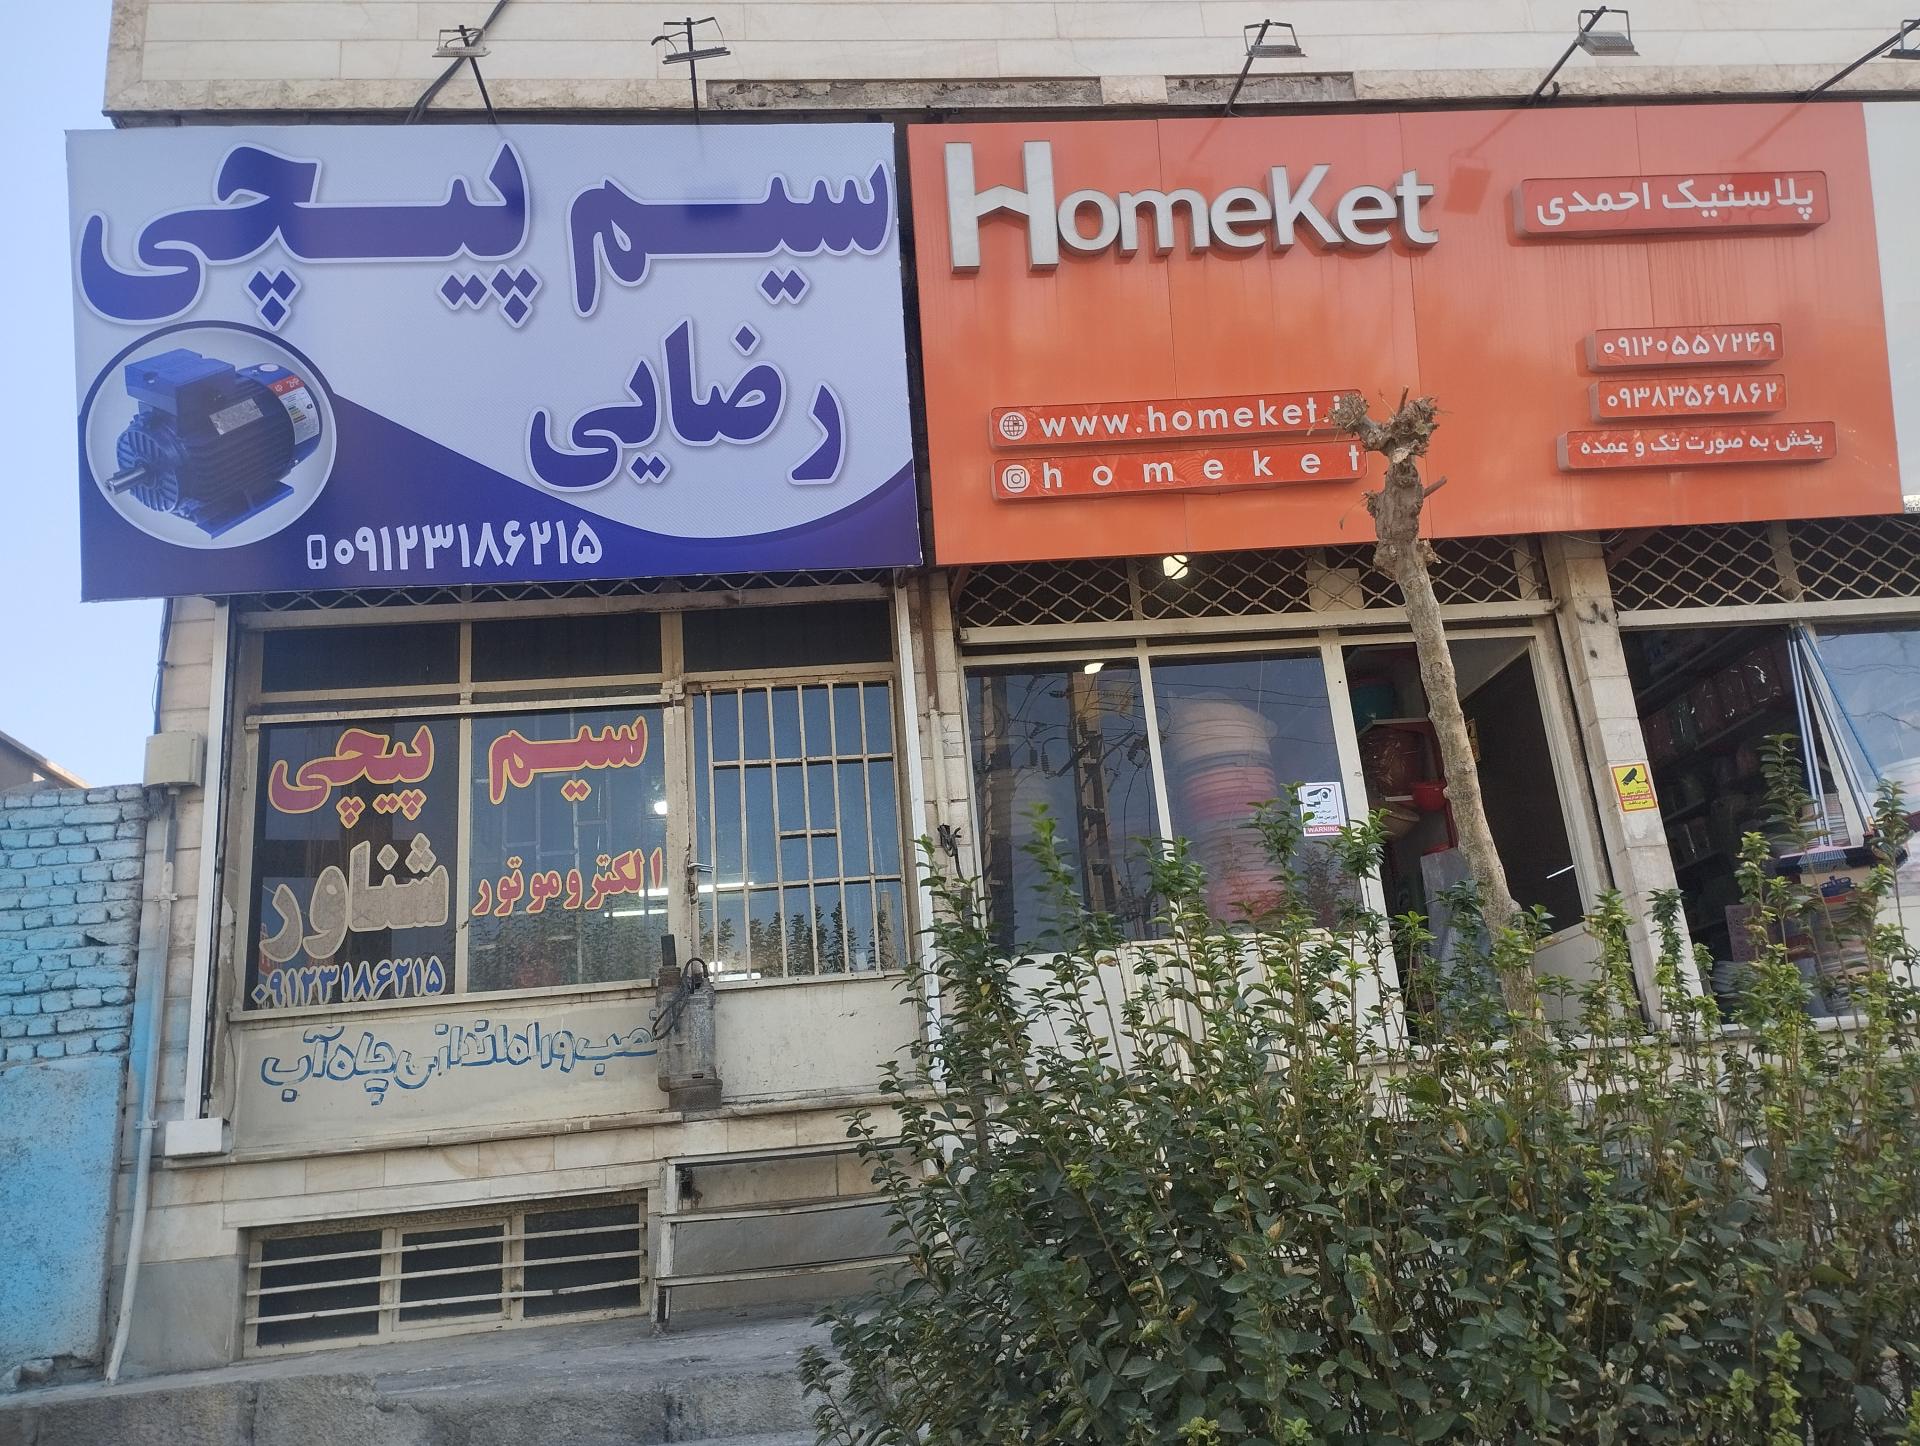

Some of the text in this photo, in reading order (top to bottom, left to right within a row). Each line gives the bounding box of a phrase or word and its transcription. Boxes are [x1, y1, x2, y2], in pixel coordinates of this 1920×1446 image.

[944, 140, 1439, 273] HomeKet
[1537, 178, 1814, 225] پلاستیک احمدی
[77, 139, 897, 331] سیم پیچی
[1603, 331, 1775, 356] ۰۹۱۲۰۵۵۷۲۴۹
[525, 316, 848, 491] رضایی
[1040, 395, 1344, 438] www.homeket.i
[1606, 382, 1778, 408] ۰۹۳۸۳۵۶۹۸۶۲
[1580, 429, 1823, 457] پخش به صورت تک و عمده
[333, 520, 603, 572] ۰۹۱۲۳۱۸۶۲۱۵
[269, 716, 648, 828] سیم پیچی
[259, 832, 449, 962] شناور
[251, 955, 446, 1008] ۰۹۱۲۳۱۸۶۲۱۵
[574, 1009, 658, 1075] صب
